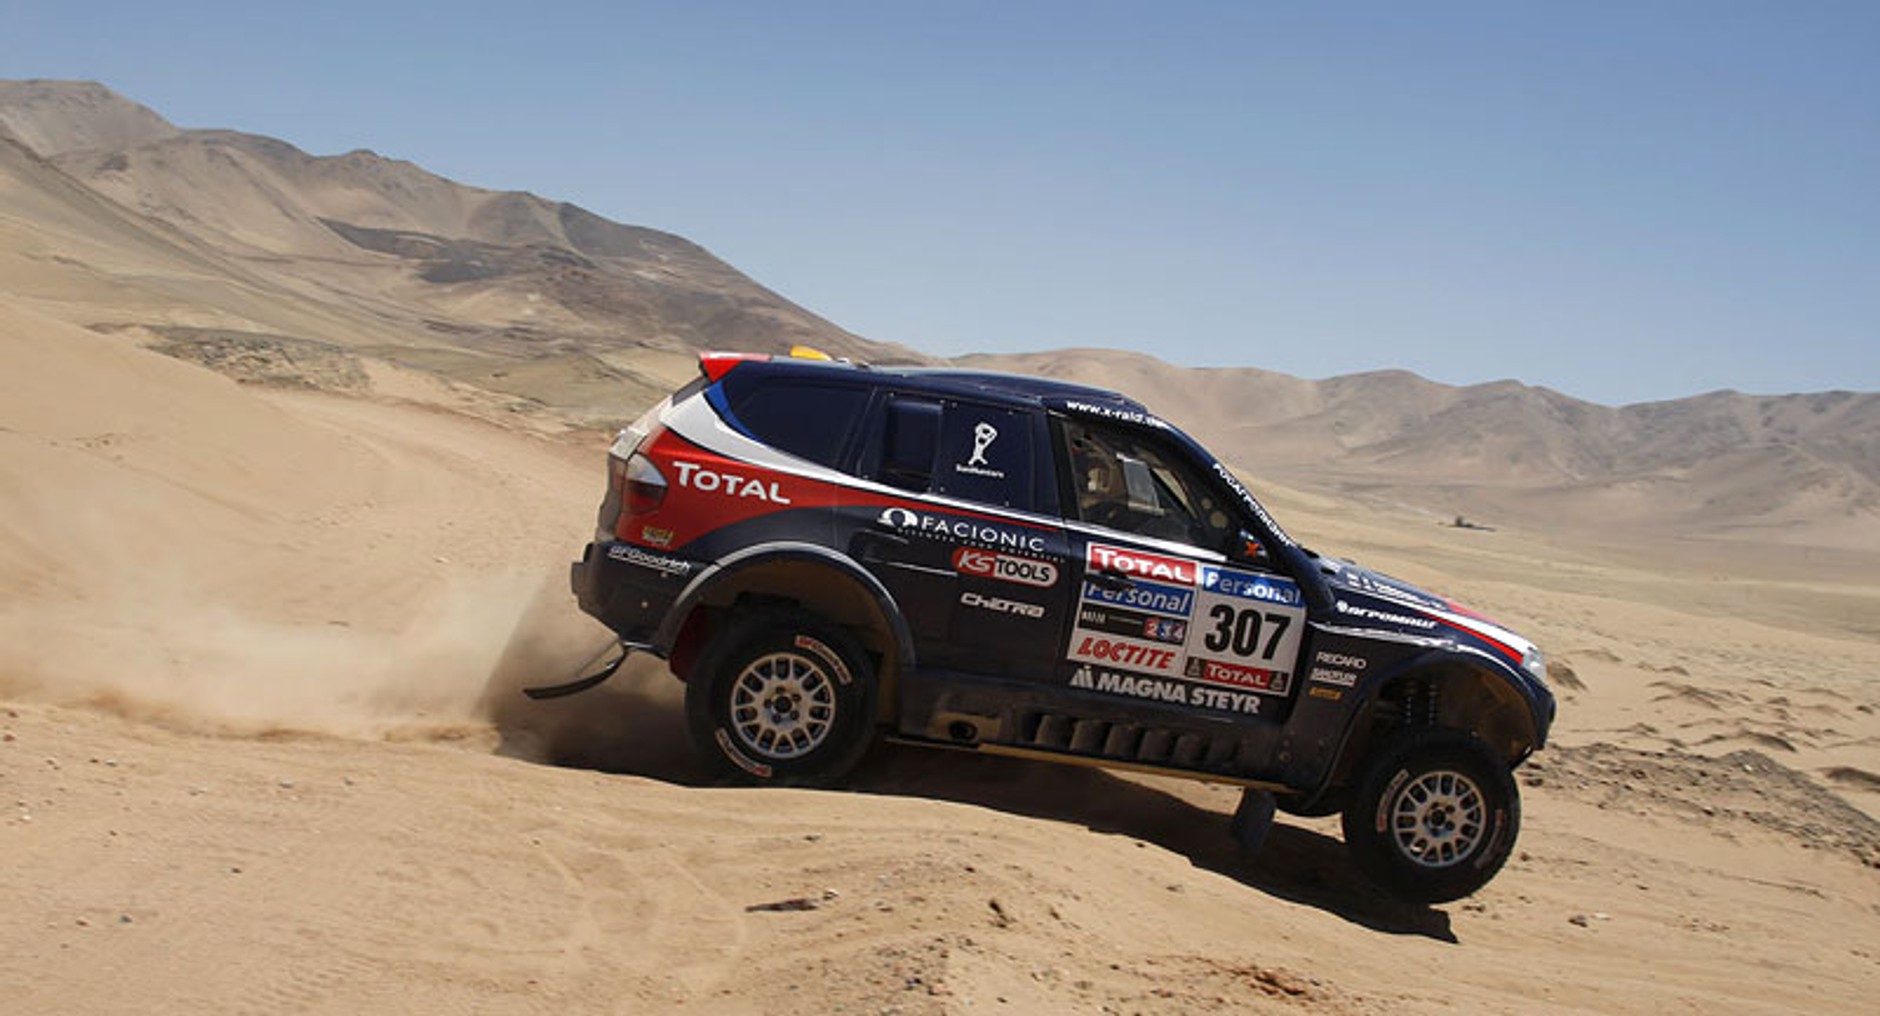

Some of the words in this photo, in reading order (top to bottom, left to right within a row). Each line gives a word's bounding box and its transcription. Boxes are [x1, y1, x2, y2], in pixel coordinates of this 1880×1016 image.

[672, 460, 791, 505] TOTAL
[921, 515, 1045, 552] FACIONIC
[958, 550, 995, 573] KS
[996, 556, 1050, 582] TOOLS
[1094, 547, 1193, 583] TOTAL
[1205, 571, 1301, 604] Personal
[1205, 603, 1292, 660] 307
[1076, 635, 1176, 669] LOCTITE
[1316, 651, 1367, 669] RECARO
[1206, 662, 1267, 686] TOTAL
[1098, 672, 1187, 704] MAGNA
[1191, 687, 1262, 715] STEYR
